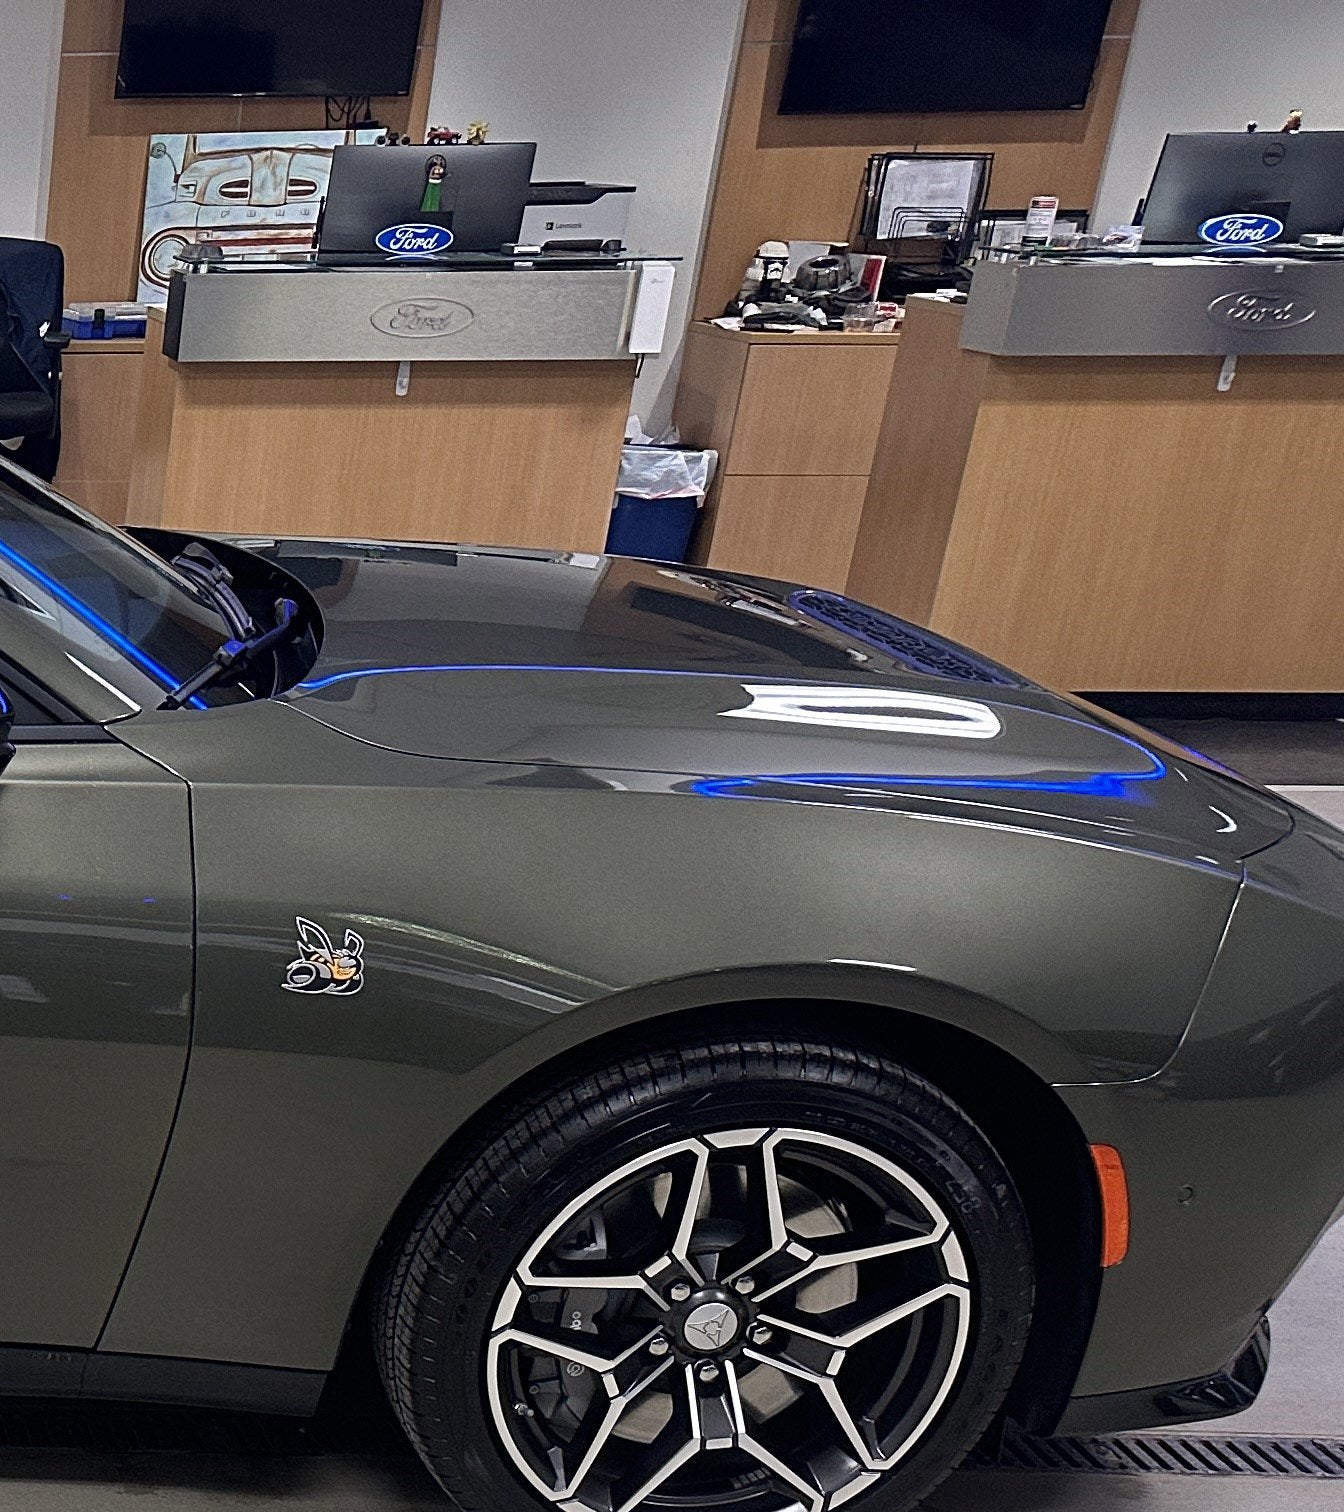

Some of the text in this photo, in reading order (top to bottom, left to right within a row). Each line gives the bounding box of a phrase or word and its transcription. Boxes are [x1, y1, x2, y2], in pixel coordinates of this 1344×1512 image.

[389, 228, 440, 250] Ford
[1216, 218, 1269, 241] Ford
[389, 303, 455, 331] Ford
[1227, 294, 1294, 322] Ford
